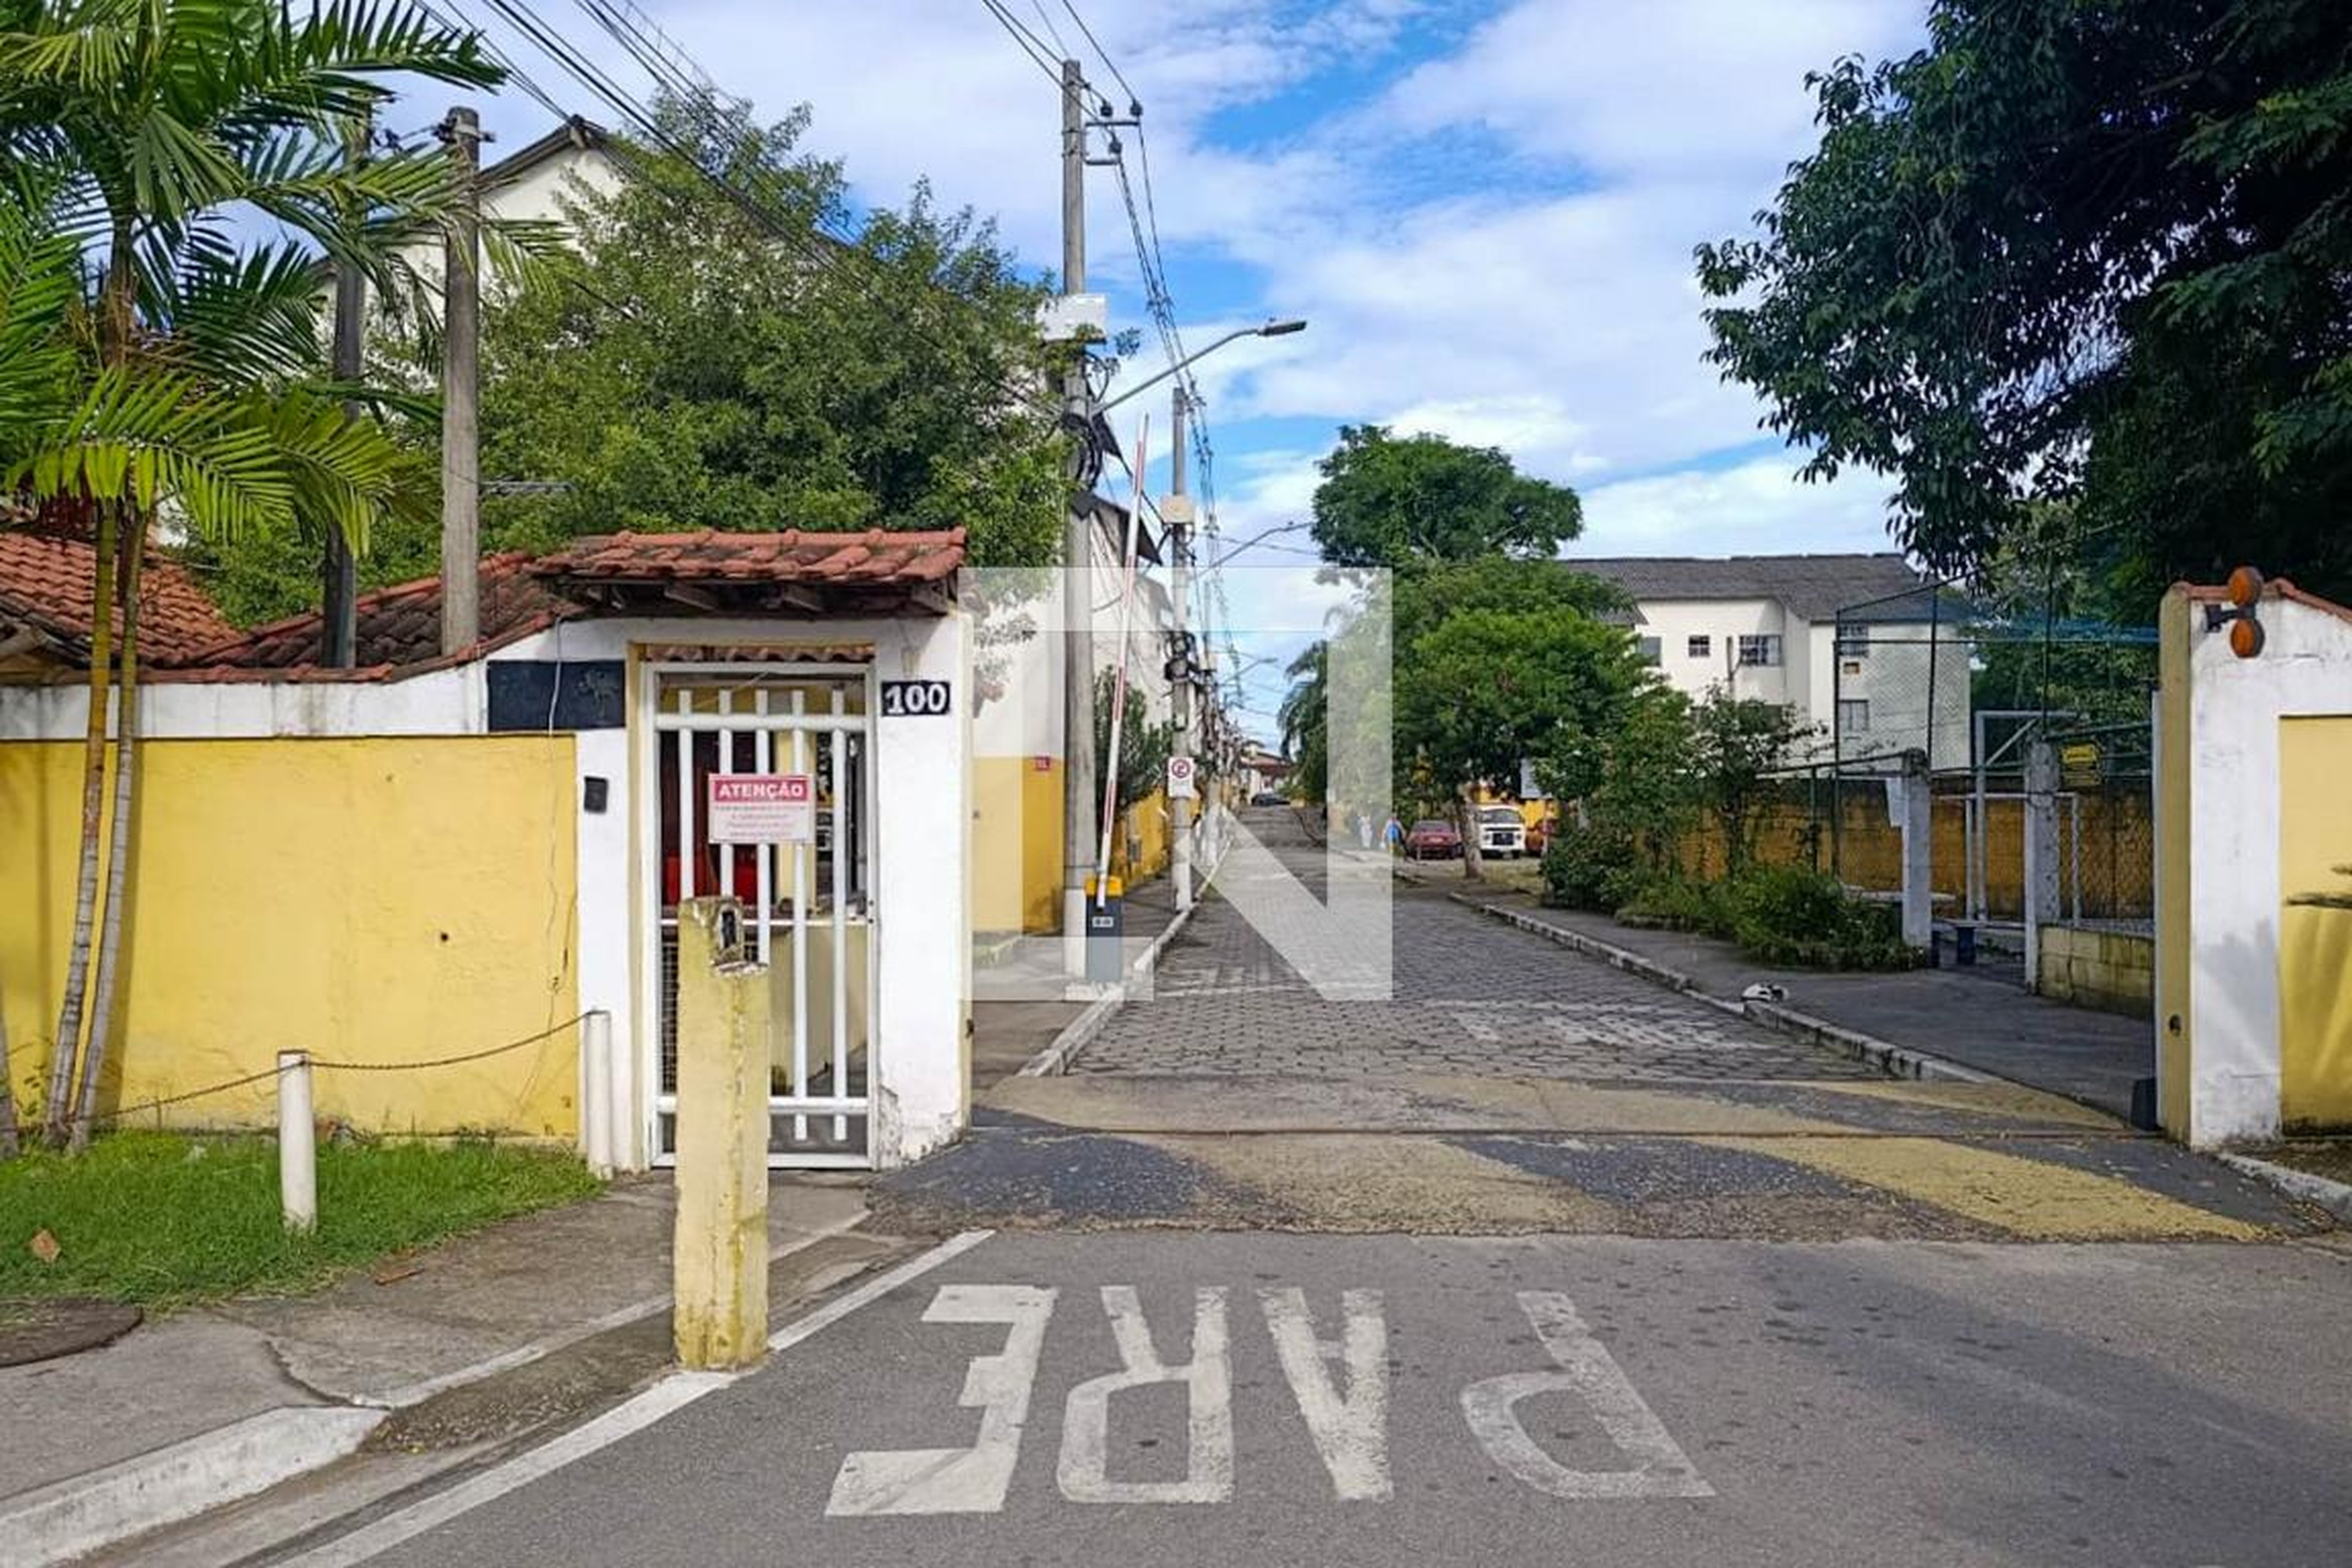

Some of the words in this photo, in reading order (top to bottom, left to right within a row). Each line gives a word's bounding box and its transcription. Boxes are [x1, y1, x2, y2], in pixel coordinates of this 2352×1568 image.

[884, 683, 946, 714] 100
[718, 781, 804, 799] ATENÇÃO
[824, 1284, 1716, 1517] PARE
